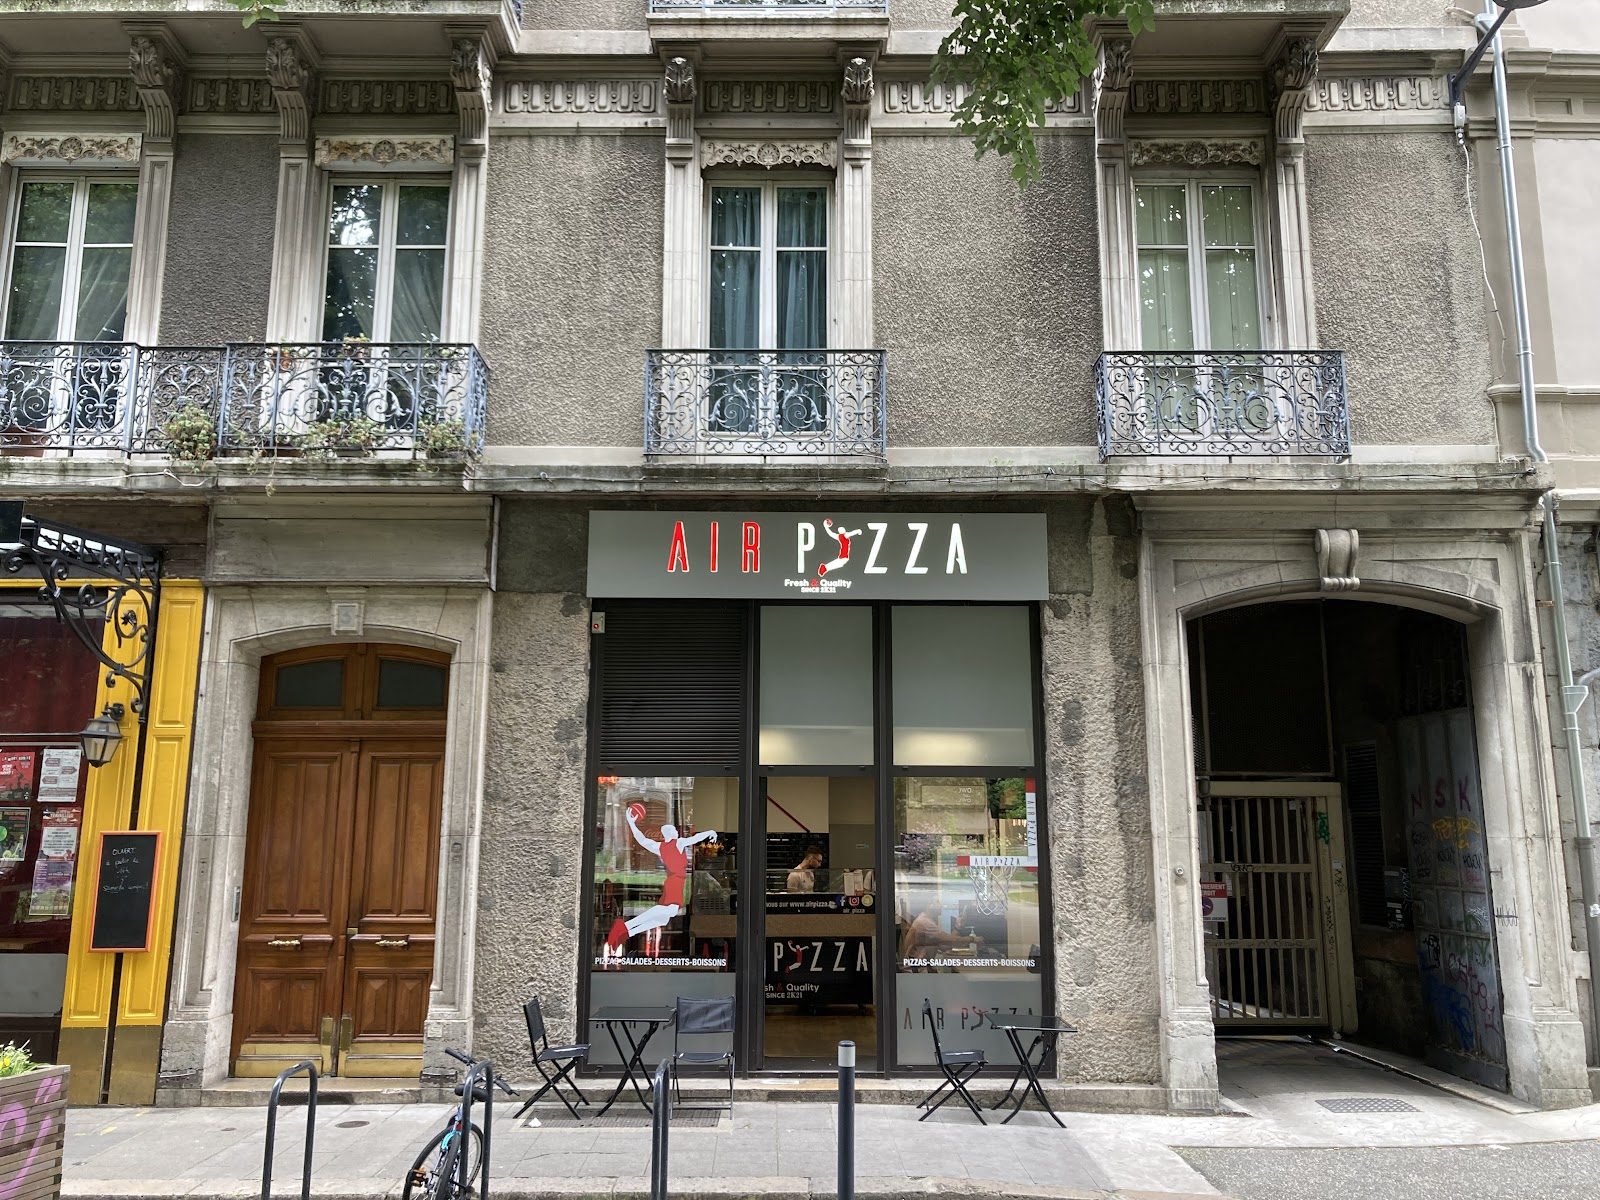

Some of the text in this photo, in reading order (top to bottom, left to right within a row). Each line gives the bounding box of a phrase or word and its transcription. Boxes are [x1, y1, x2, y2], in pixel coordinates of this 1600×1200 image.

[667, 518, 968, 577] AIR PIZZA
[784, 578, 852, 589] Fresh & Quality
[974, 857, 990, 866] AIR
[786, 983, 820, 993] Quality
